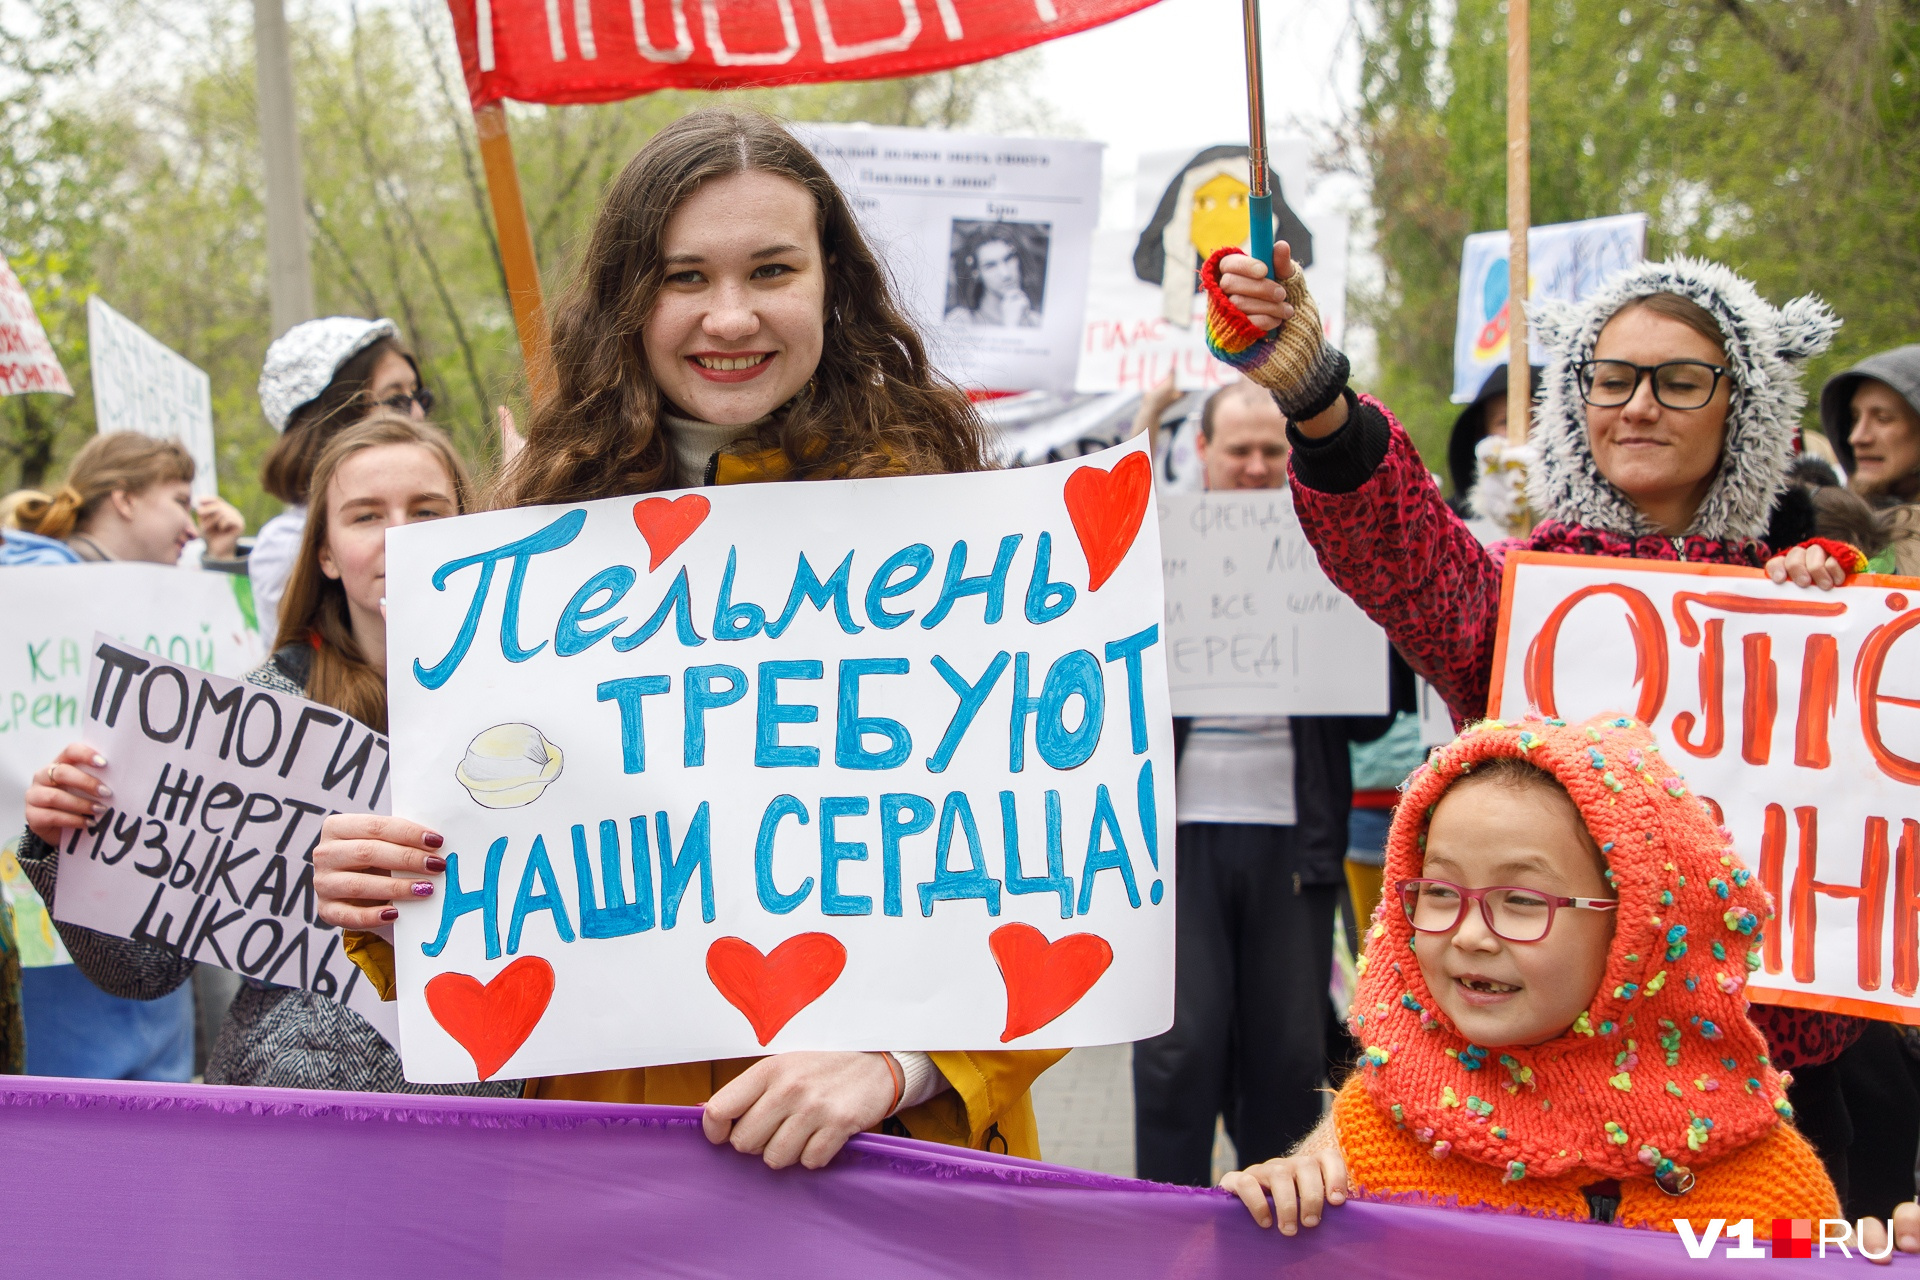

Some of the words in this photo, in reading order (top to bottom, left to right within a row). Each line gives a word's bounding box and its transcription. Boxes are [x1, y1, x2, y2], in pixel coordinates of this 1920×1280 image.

[413, 508, 1077, 690] Пельмень
[90, 643, 389, 811] ПОМОГИТ
[597, 623, 1159, 775] ТРЕБУЮТ
[66, 807, 336, 931] МУЗЫКАЛ
[420, 800, 716, 960] НАШИ
[754, 758, 1162, 919] СЕРДЦА!
[129, 882, 361, 1005] ШКОЛЫ
